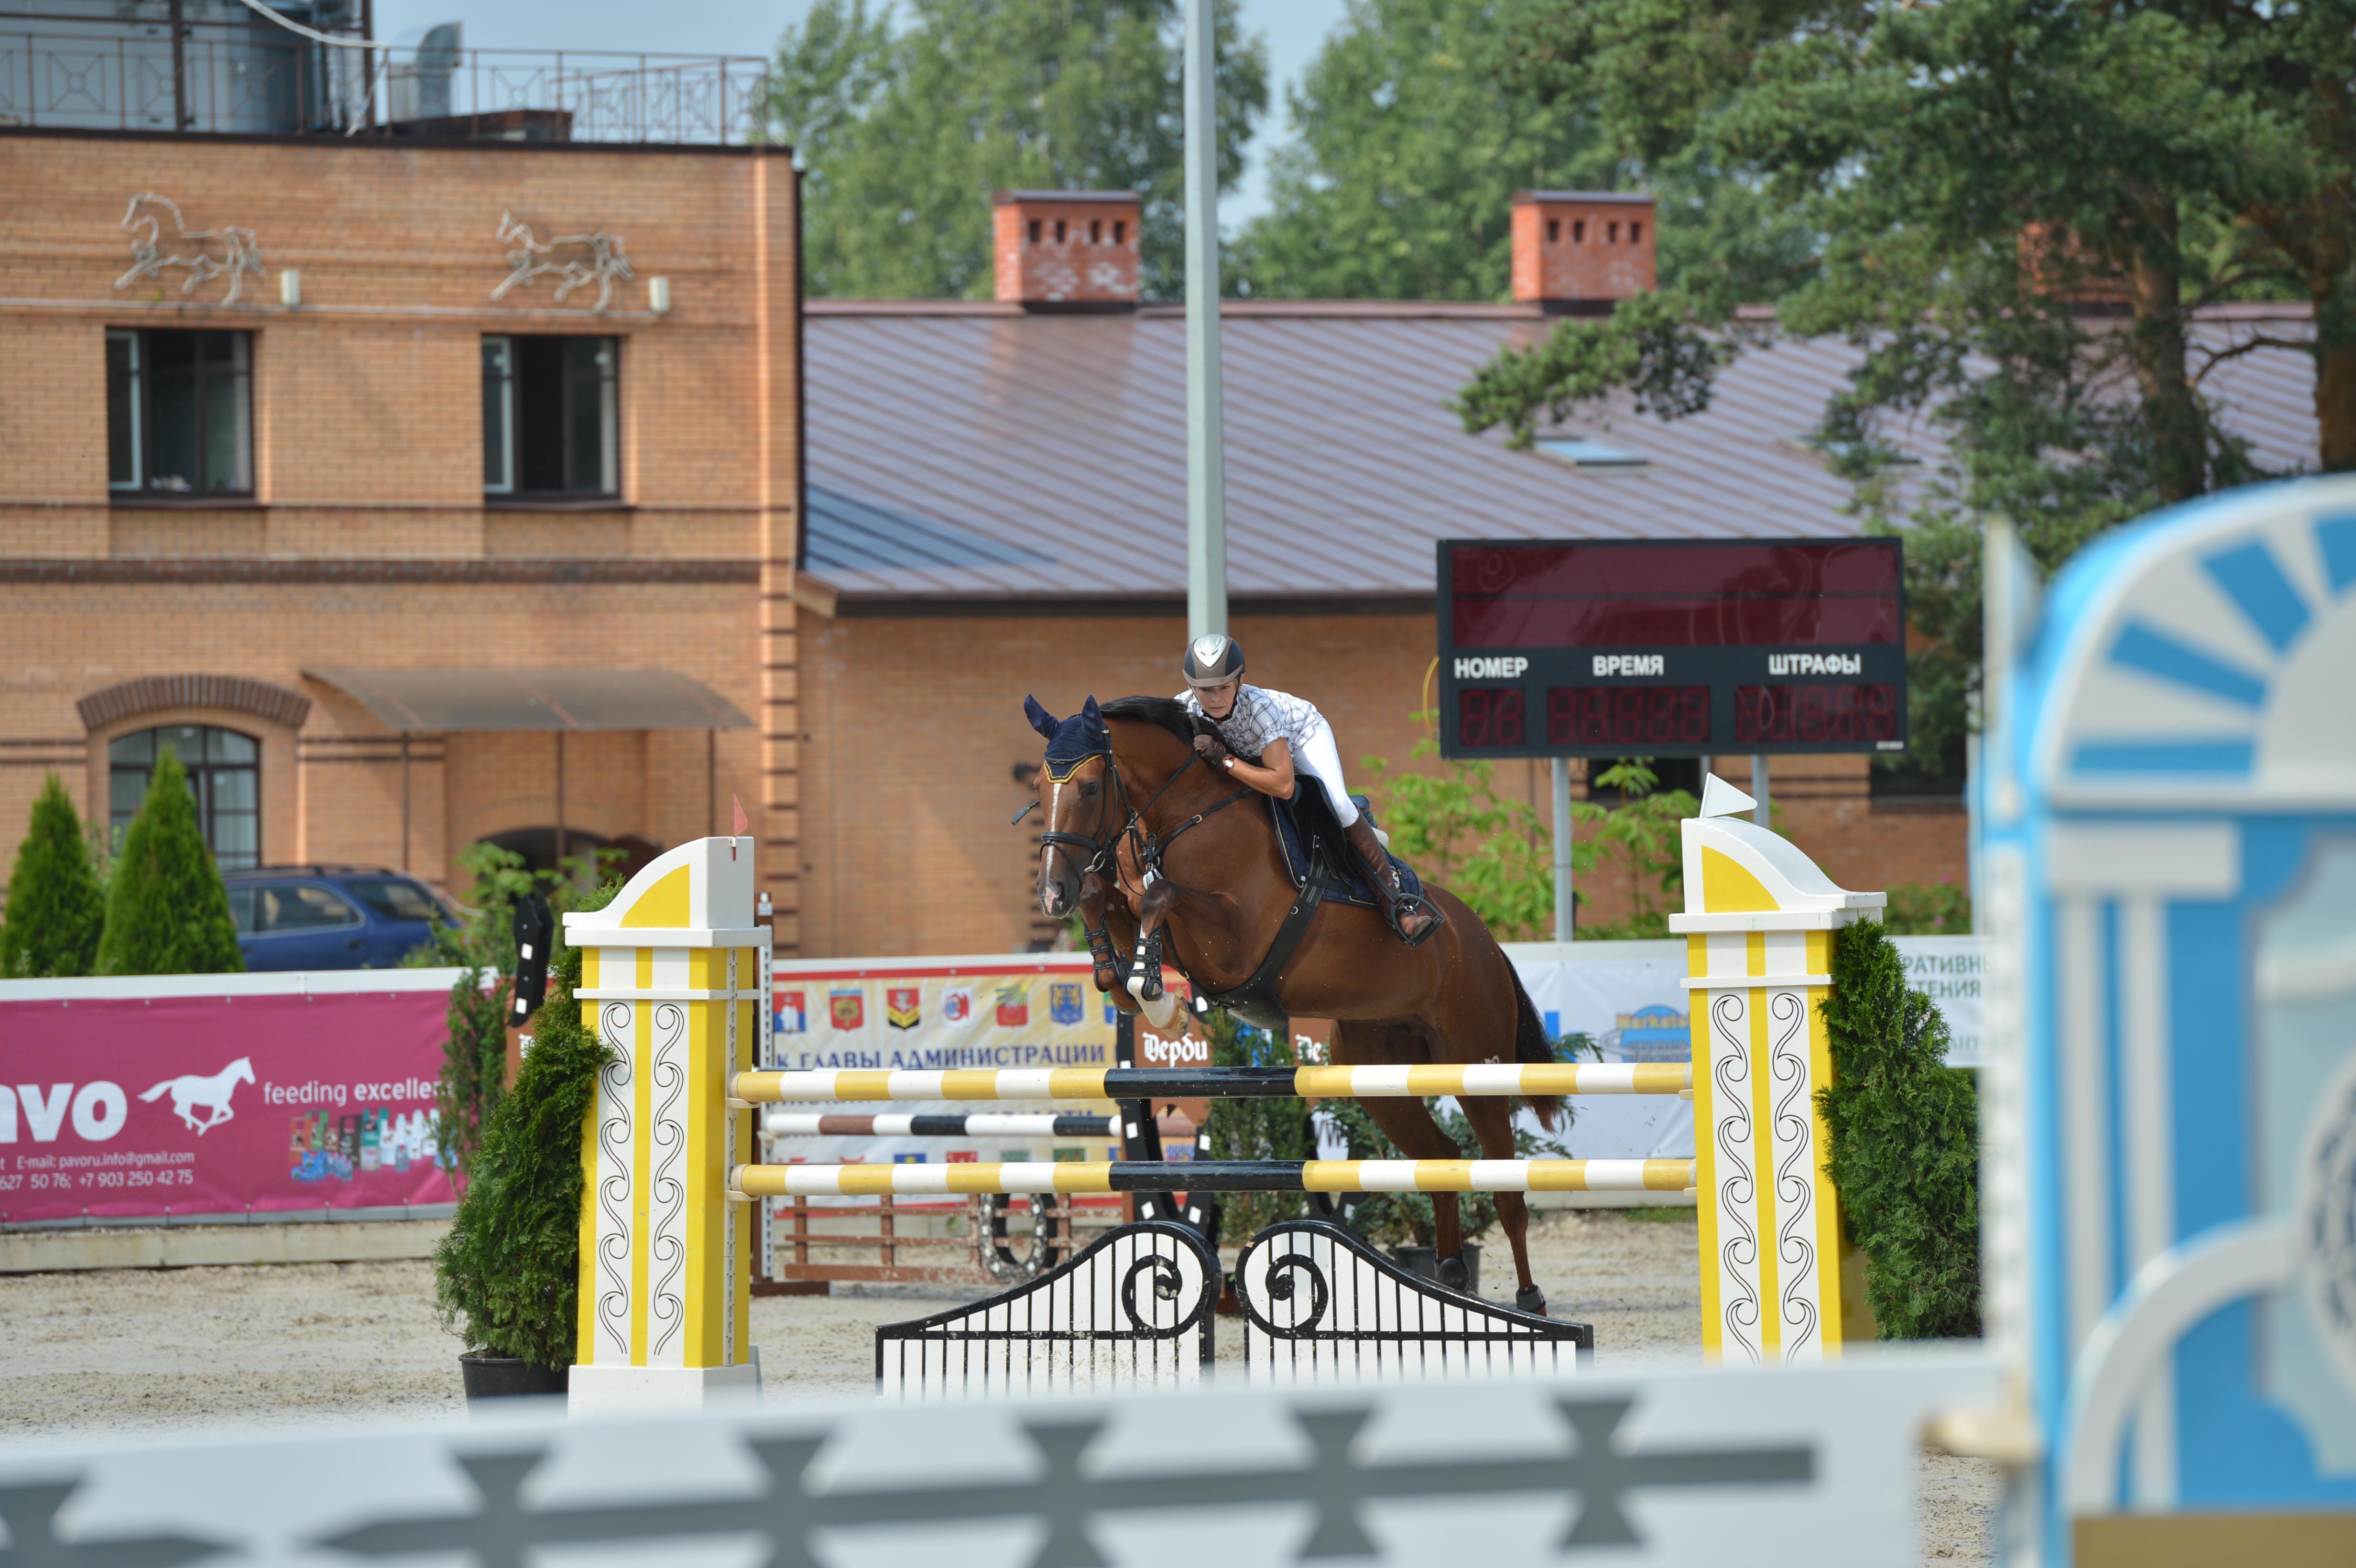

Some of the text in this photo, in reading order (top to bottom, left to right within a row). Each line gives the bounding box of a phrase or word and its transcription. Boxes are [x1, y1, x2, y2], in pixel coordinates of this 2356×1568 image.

[1454, 657, 1528, 679] НОМЕР
[1592, 655, 1664, 676] ВРЕМЯ
[1768, 653, 1861, 675] ШТРАФЫ
[1906, 980, 1981, 998] ТЕНИЯ
[800, 1050, 882, 1068] ГЛАВЫ
[891, 1045, 1105, 1069] АДМИНИСТРАЦИИ
[263, 1080, 347, 1107] feeding
[59, 1151, 195, 1169] pavoru.info@gmail.com
[31, 1173, 49, 1189] 50
[78, 1173, 94, 1188] +7
[98, 1171, 124, 1187] 903
[127, 1170, 153, 1187] 250
[156, 1169, 174, 1186] 42
[177, 1169, 194, 1185] 75
